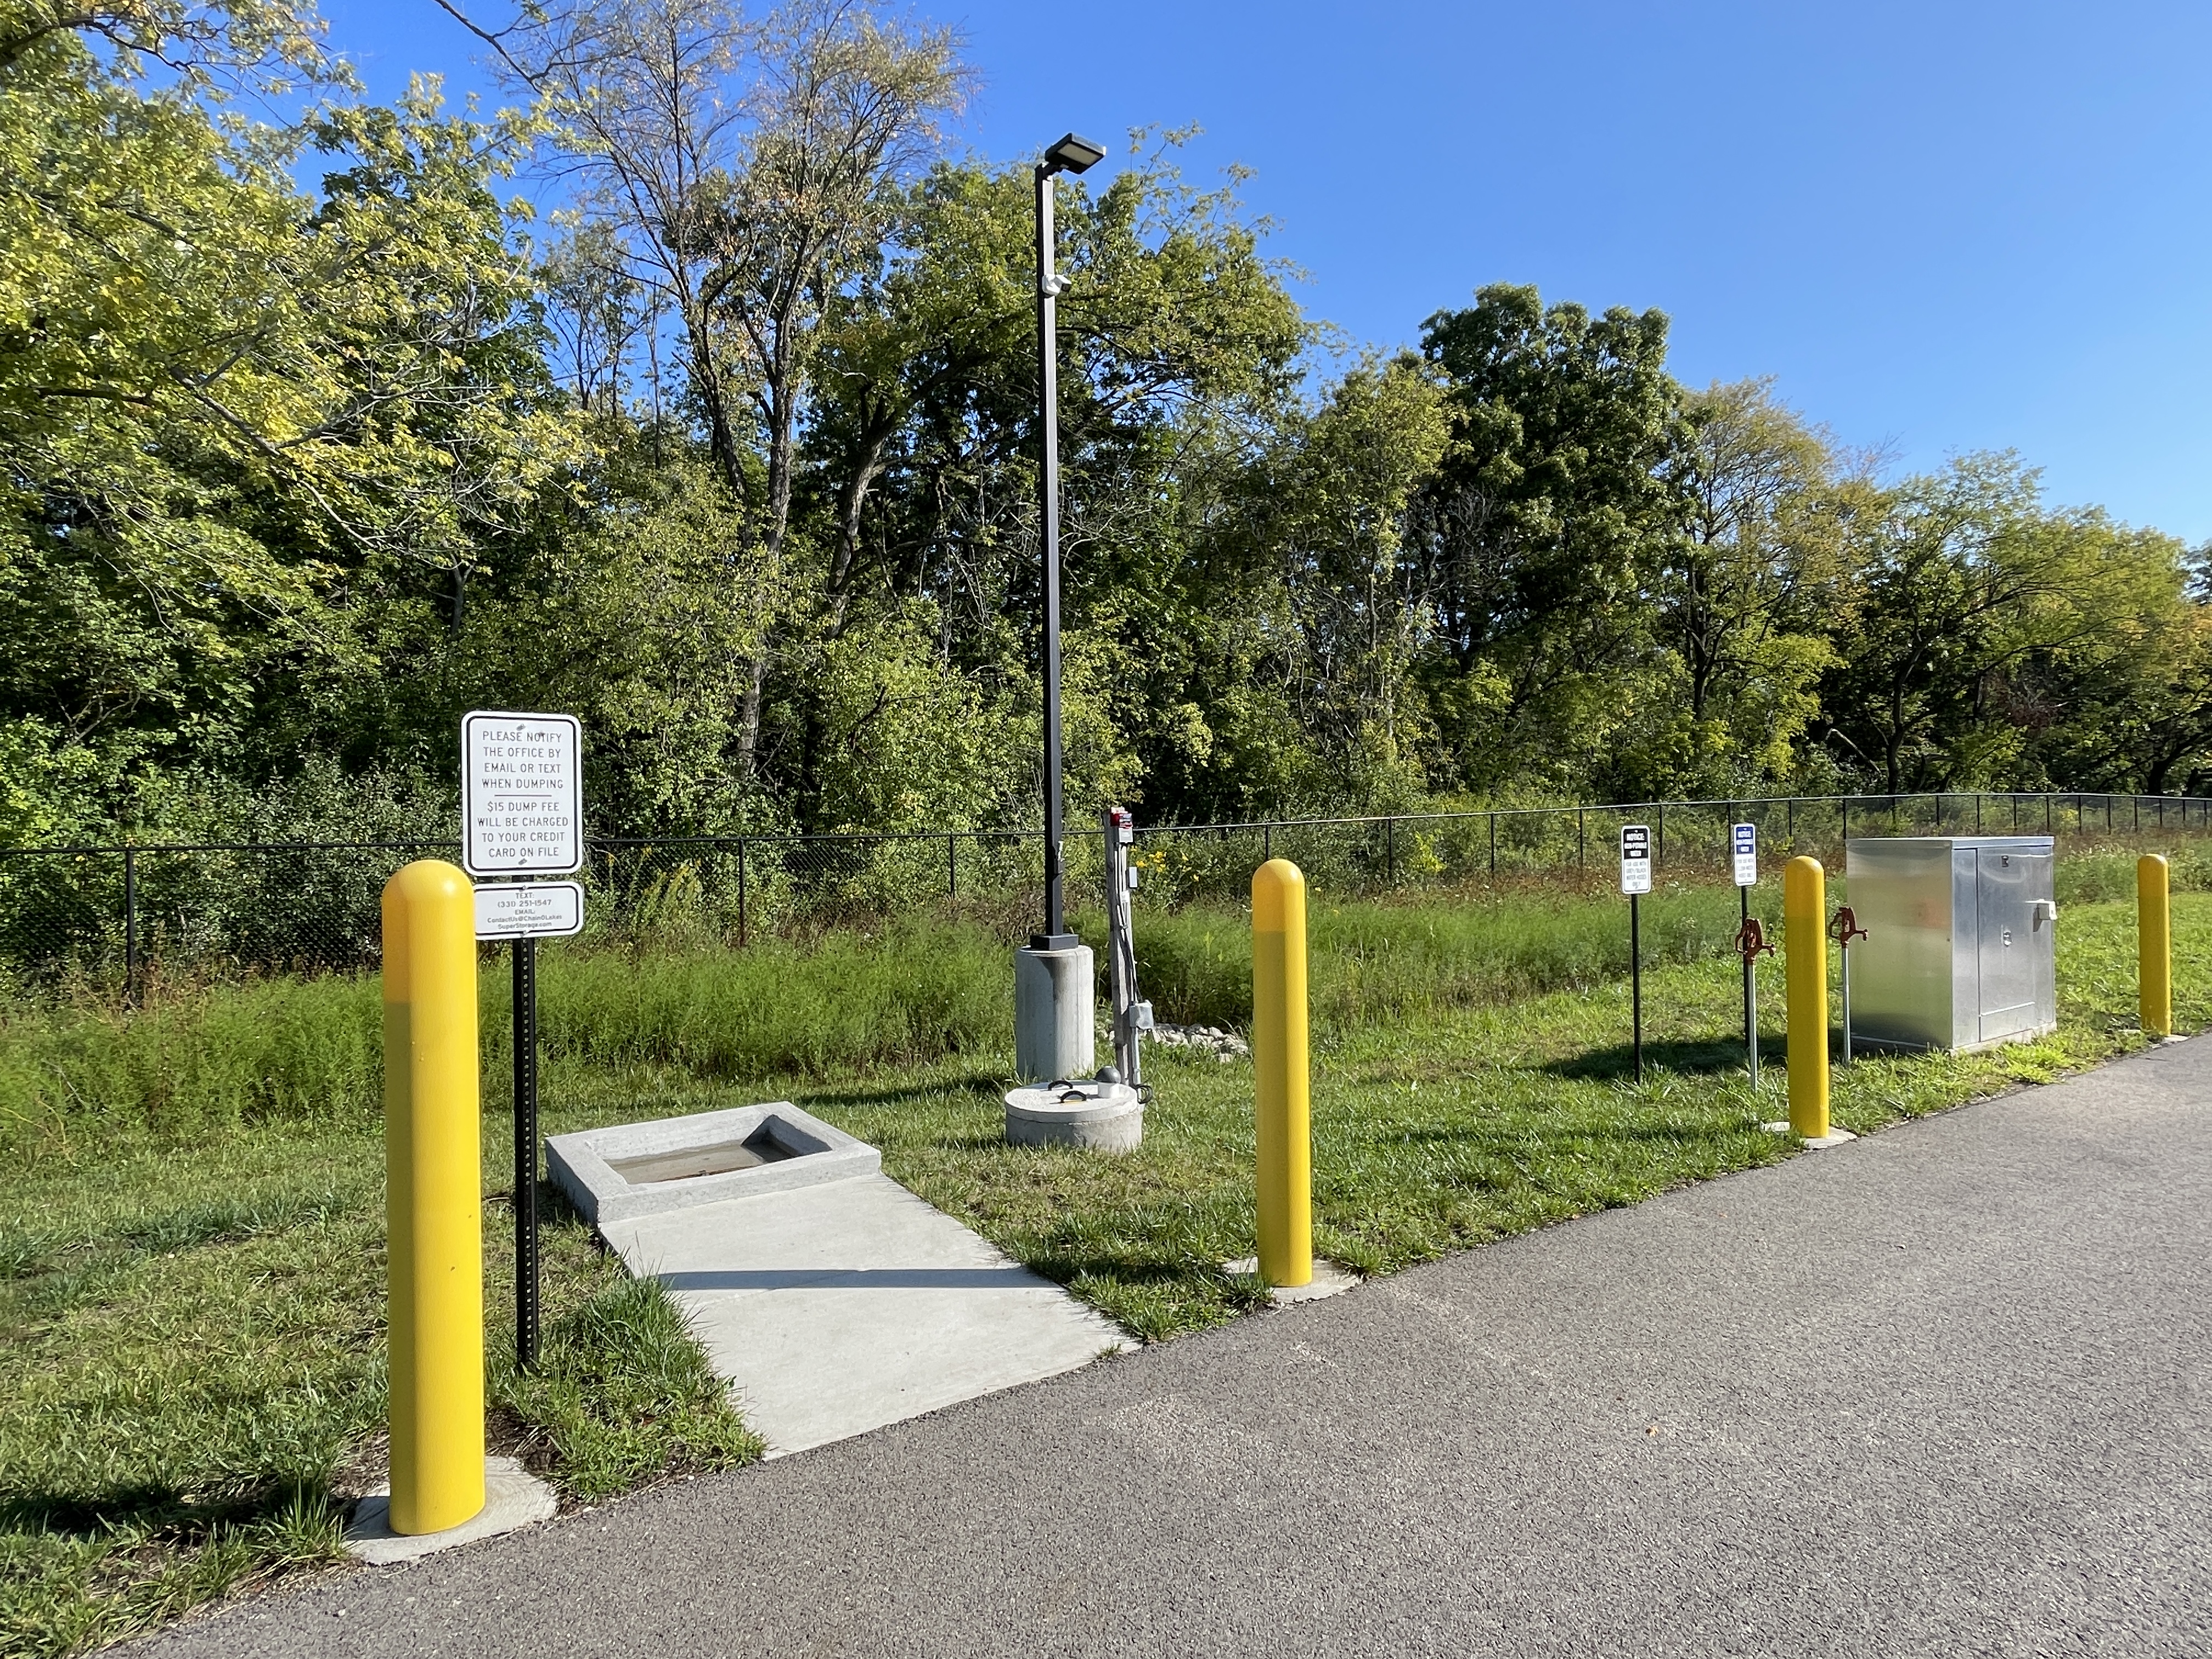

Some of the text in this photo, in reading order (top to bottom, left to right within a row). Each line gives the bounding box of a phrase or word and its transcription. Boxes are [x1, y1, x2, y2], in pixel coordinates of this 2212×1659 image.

[483, 731, 562, 743] PLEASE NOTIFY
[483, 747, 561, 758] THE OFFICE BY
[484, 763, 561, 774] EMAIL OR TEXT
[482, 778, 563, 789] WHEN DUMPING
[487, 801, 560, 812] $15 DUMP FEE
[477, 817, 568, 827] WILL BE CHARGED
[482, 832, 565, 843] TO YOUR CREDIT
[488, 847, 559, 857] CARD ON FILE
[519, 899, 552, 907] 251-1547
